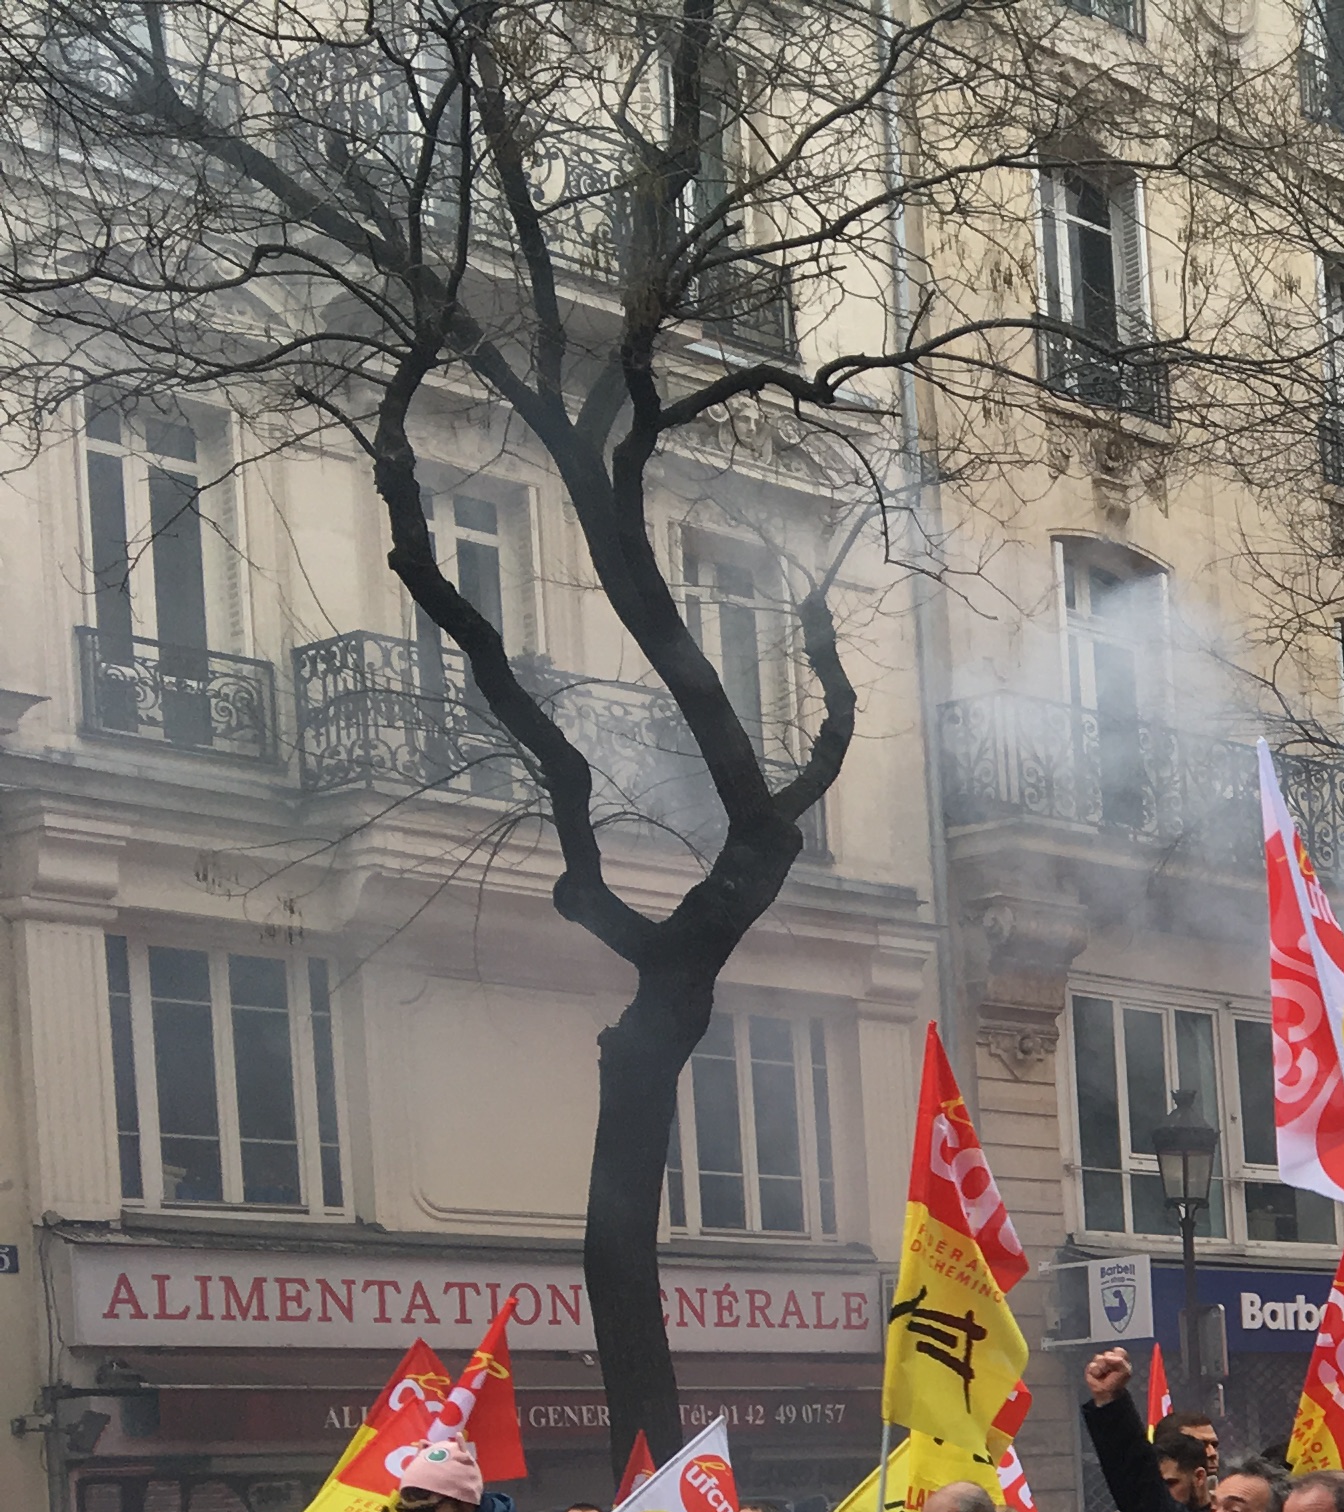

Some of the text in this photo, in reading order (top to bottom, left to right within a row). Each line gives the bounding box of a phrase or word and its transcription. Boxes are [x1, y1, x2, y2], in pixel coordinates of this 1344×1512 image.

[1100, 1264, 1136, 1278] Barbell
[102, 1271, 870, 1331] ALIMENTATION NÉRALE
[1240, 1292, 1325, 1331] Barb
[528, 1404, 612, 1429] GENER
[744, 1405, 765, 1425] 42
[774, 1405, 797, 1425] 49
